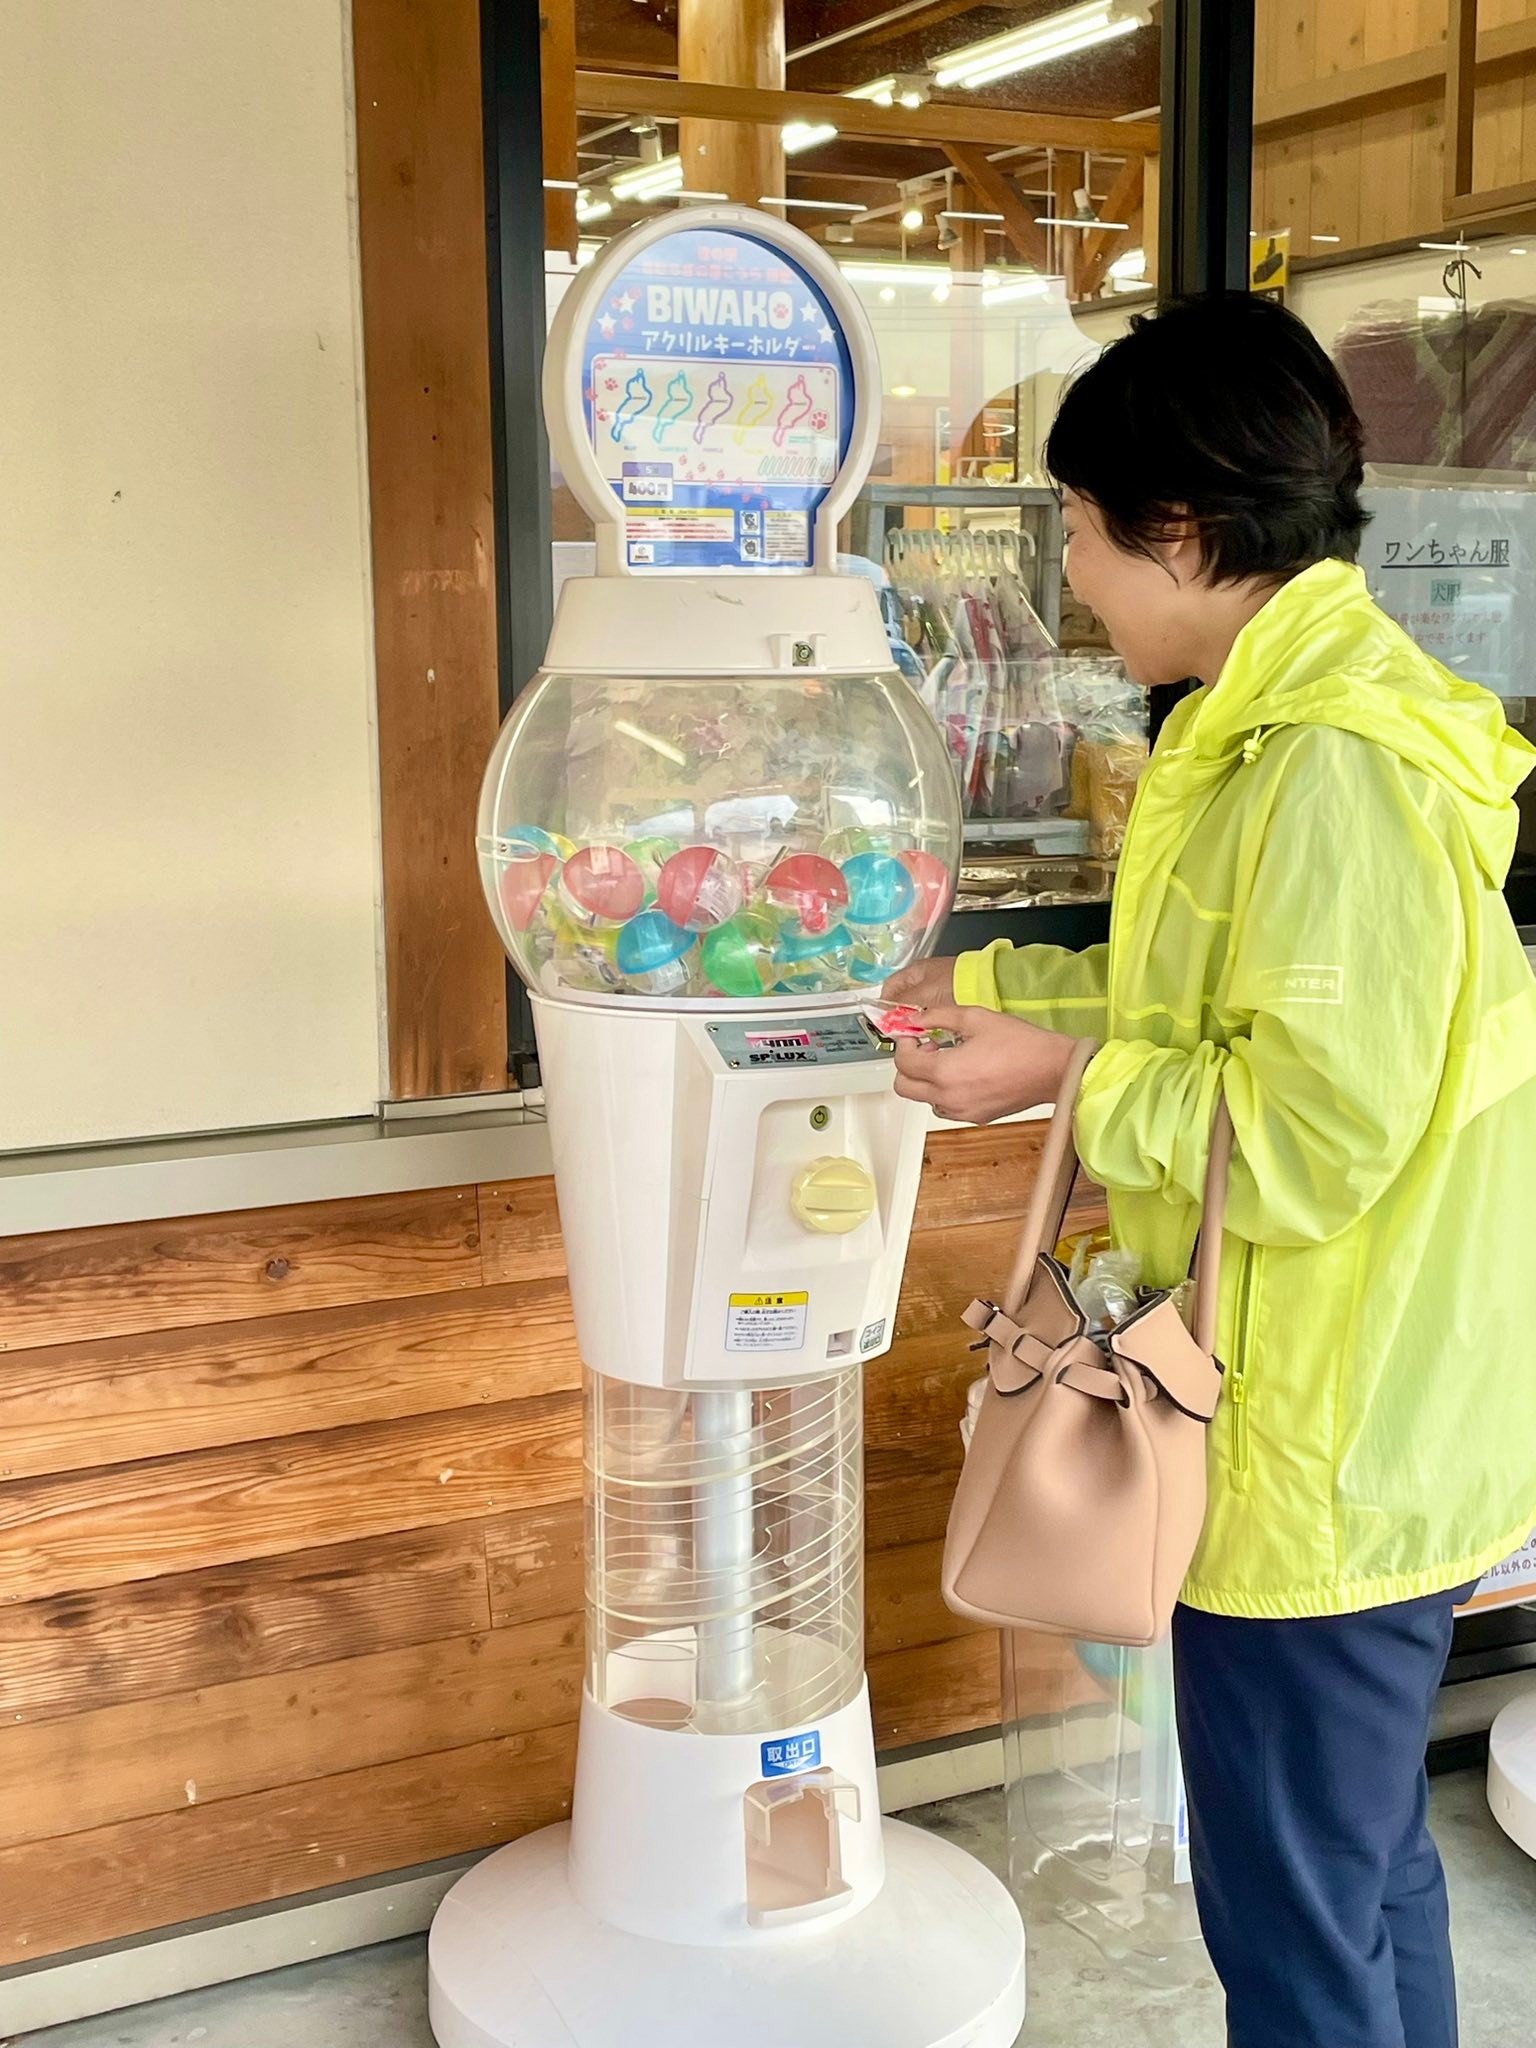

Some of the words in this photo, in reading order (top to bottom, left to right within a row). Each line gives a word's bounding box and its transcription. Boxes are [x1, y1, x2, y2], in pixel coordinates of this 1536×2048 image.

[647, 284, 793, 330] BIWAKO
[641, 330, 816, 358] アクリルキーホルダー
[1385, 539, 1510, 565] ワンちゃん服
[766, 1738, 816, 1762] 取出口
